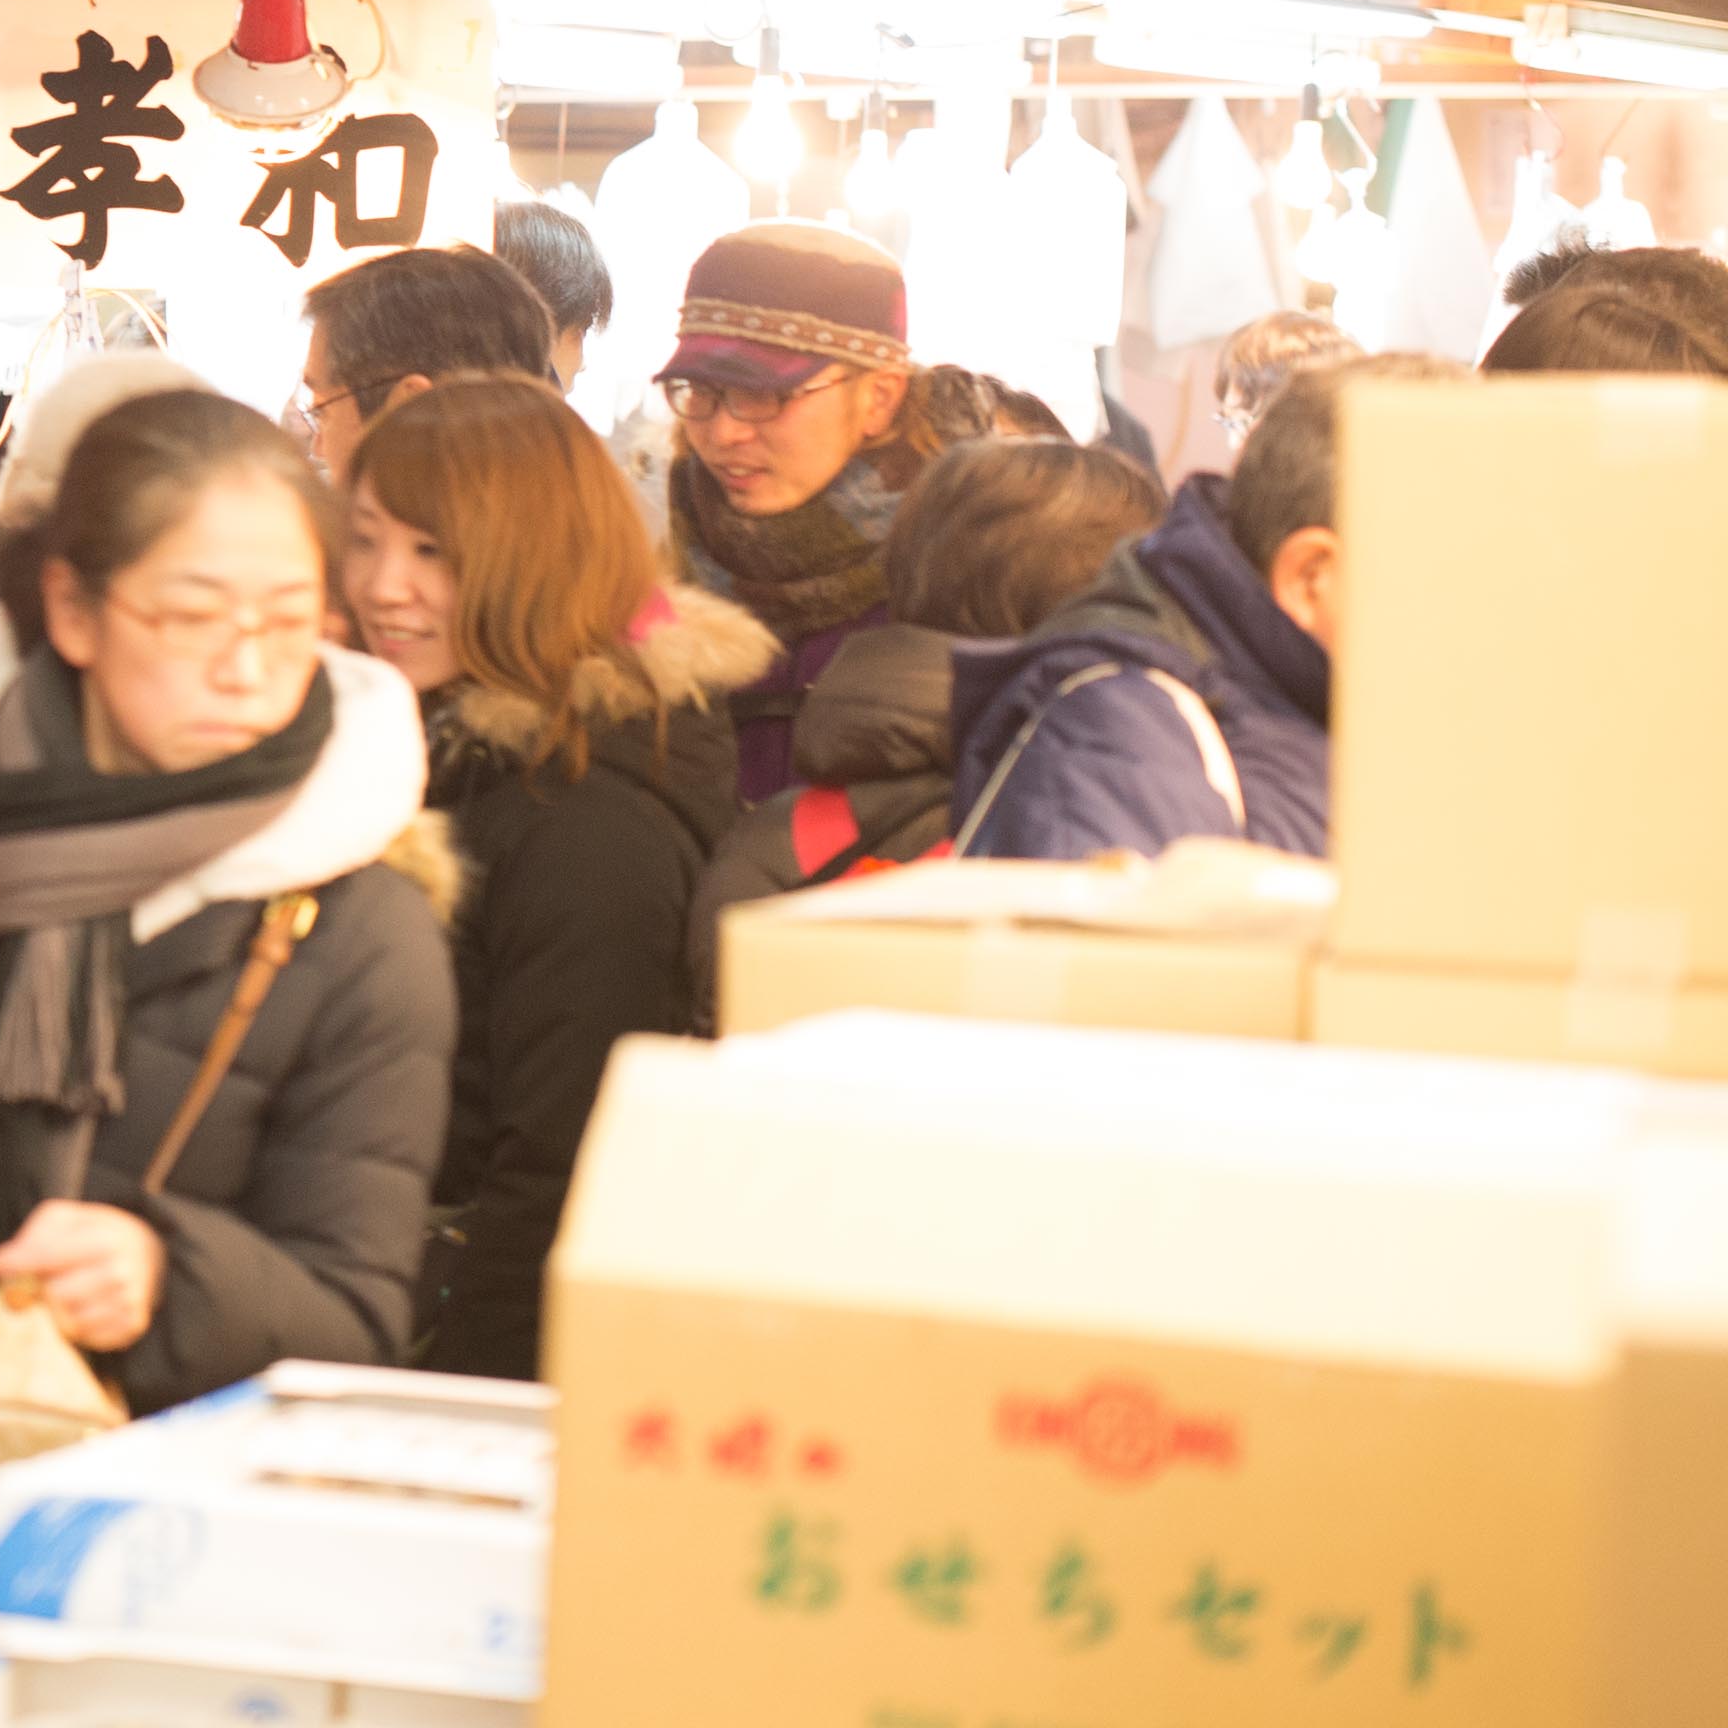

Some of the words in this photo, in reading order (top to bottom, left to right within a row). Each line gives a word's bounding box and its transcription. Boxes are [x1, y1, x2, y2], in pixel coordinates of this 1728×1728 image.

[752, 1507, 1472, 1694] おせちセット
